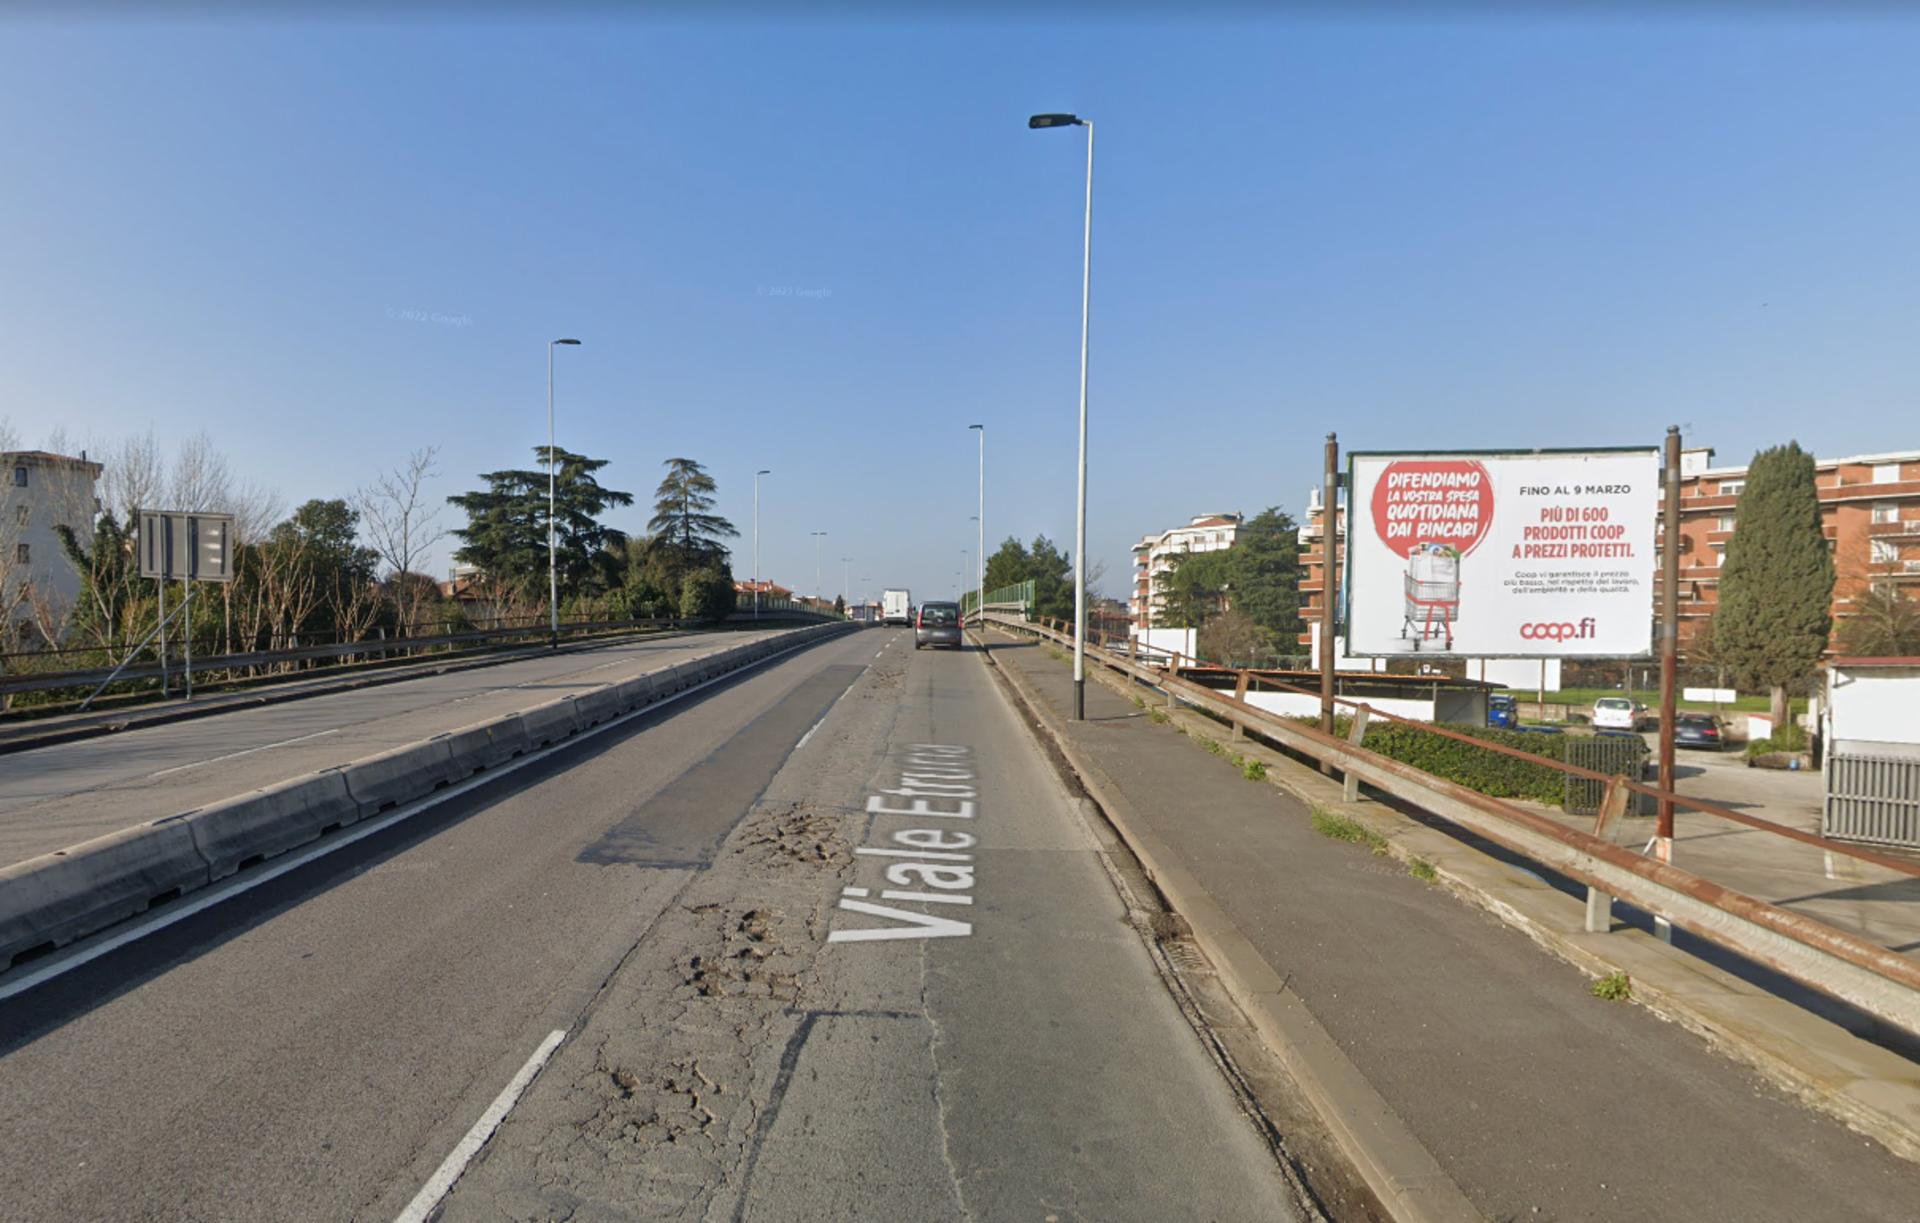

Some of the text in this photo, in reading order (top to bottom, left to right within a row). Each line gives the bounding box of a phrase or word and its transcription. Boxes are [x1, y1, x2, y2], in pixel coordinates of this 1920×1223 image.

[1387, 471, 1480, 489] DIFENDIAMO
[1387, 489, 1480, 503] LA VOSTRA SPESA
[1519, 484, 1631, 496] FINO AL 9 MARZO
[1386, 503, 1480, 521] QUOTIDIANA
[1566, 507, 1580, 522] DI
[1582, 506, 1609, 522] 600
[1387, 521, 1478, 539] DAI RINCARI
[1523, 524, 1625, 541] PRODOTTI COOP
[1512, 542, 1635, 559] A PREZZI PROTETTI.
[1514, 571, 1537, 579] Coop
[1519, 617, 1596, 643] coop.fi
